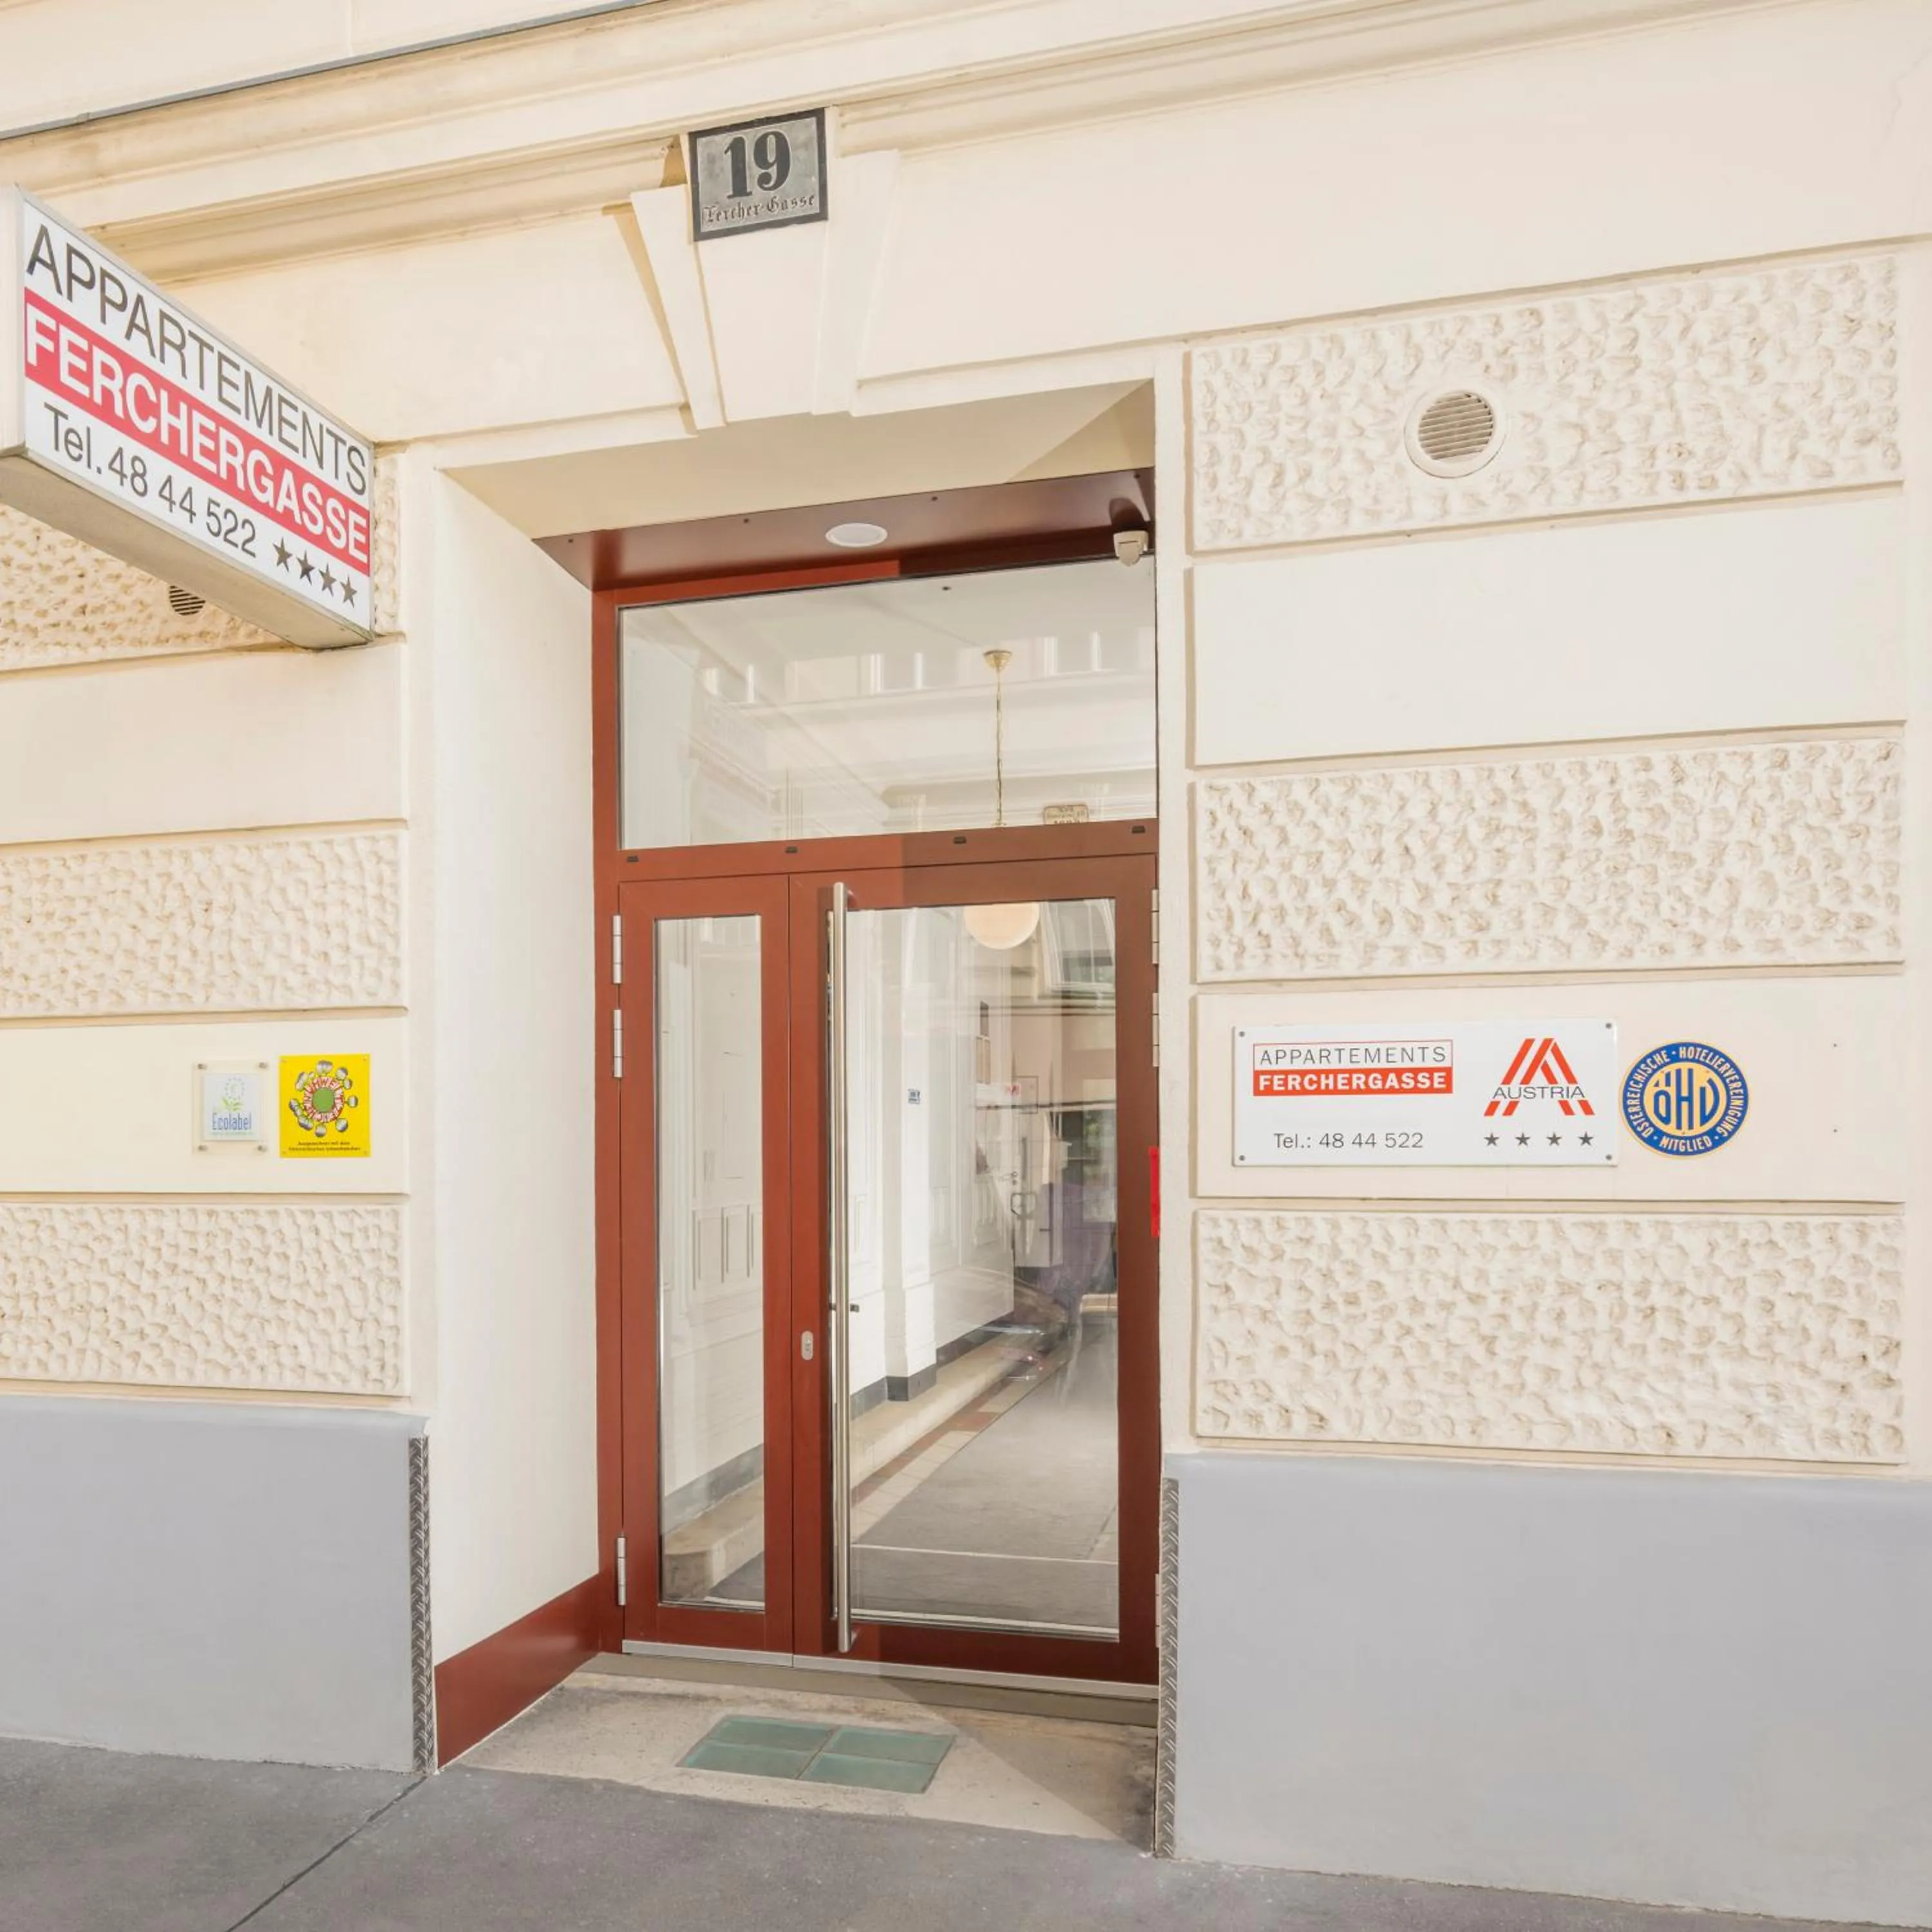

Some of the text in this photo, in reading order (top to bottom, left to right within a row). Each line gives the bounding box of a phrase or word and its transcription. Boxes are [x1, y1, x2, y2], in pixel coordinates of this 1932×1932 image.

[724, 131, 791, 198] 19
[26, 224, 366, 495] APPARTEMENTS
[27, 302, 368, 564] FERCHERGASSE
[44, 402, 256, 558] Tel. 48 44 522
[1260, 1046, 1446, 1065] APPARTEMENTS
[1259, 1072, 1446, 1090] FERCHERGASSE
[1492, 1086, 1586, 1099] AUSTRIA
[212, 1112, 252, 1130] Ecolabel
[1274, 1133, 1424, 1149] Tel.: 48 44 522
[1659, 1135, 1712, 1152] MITGLIED
